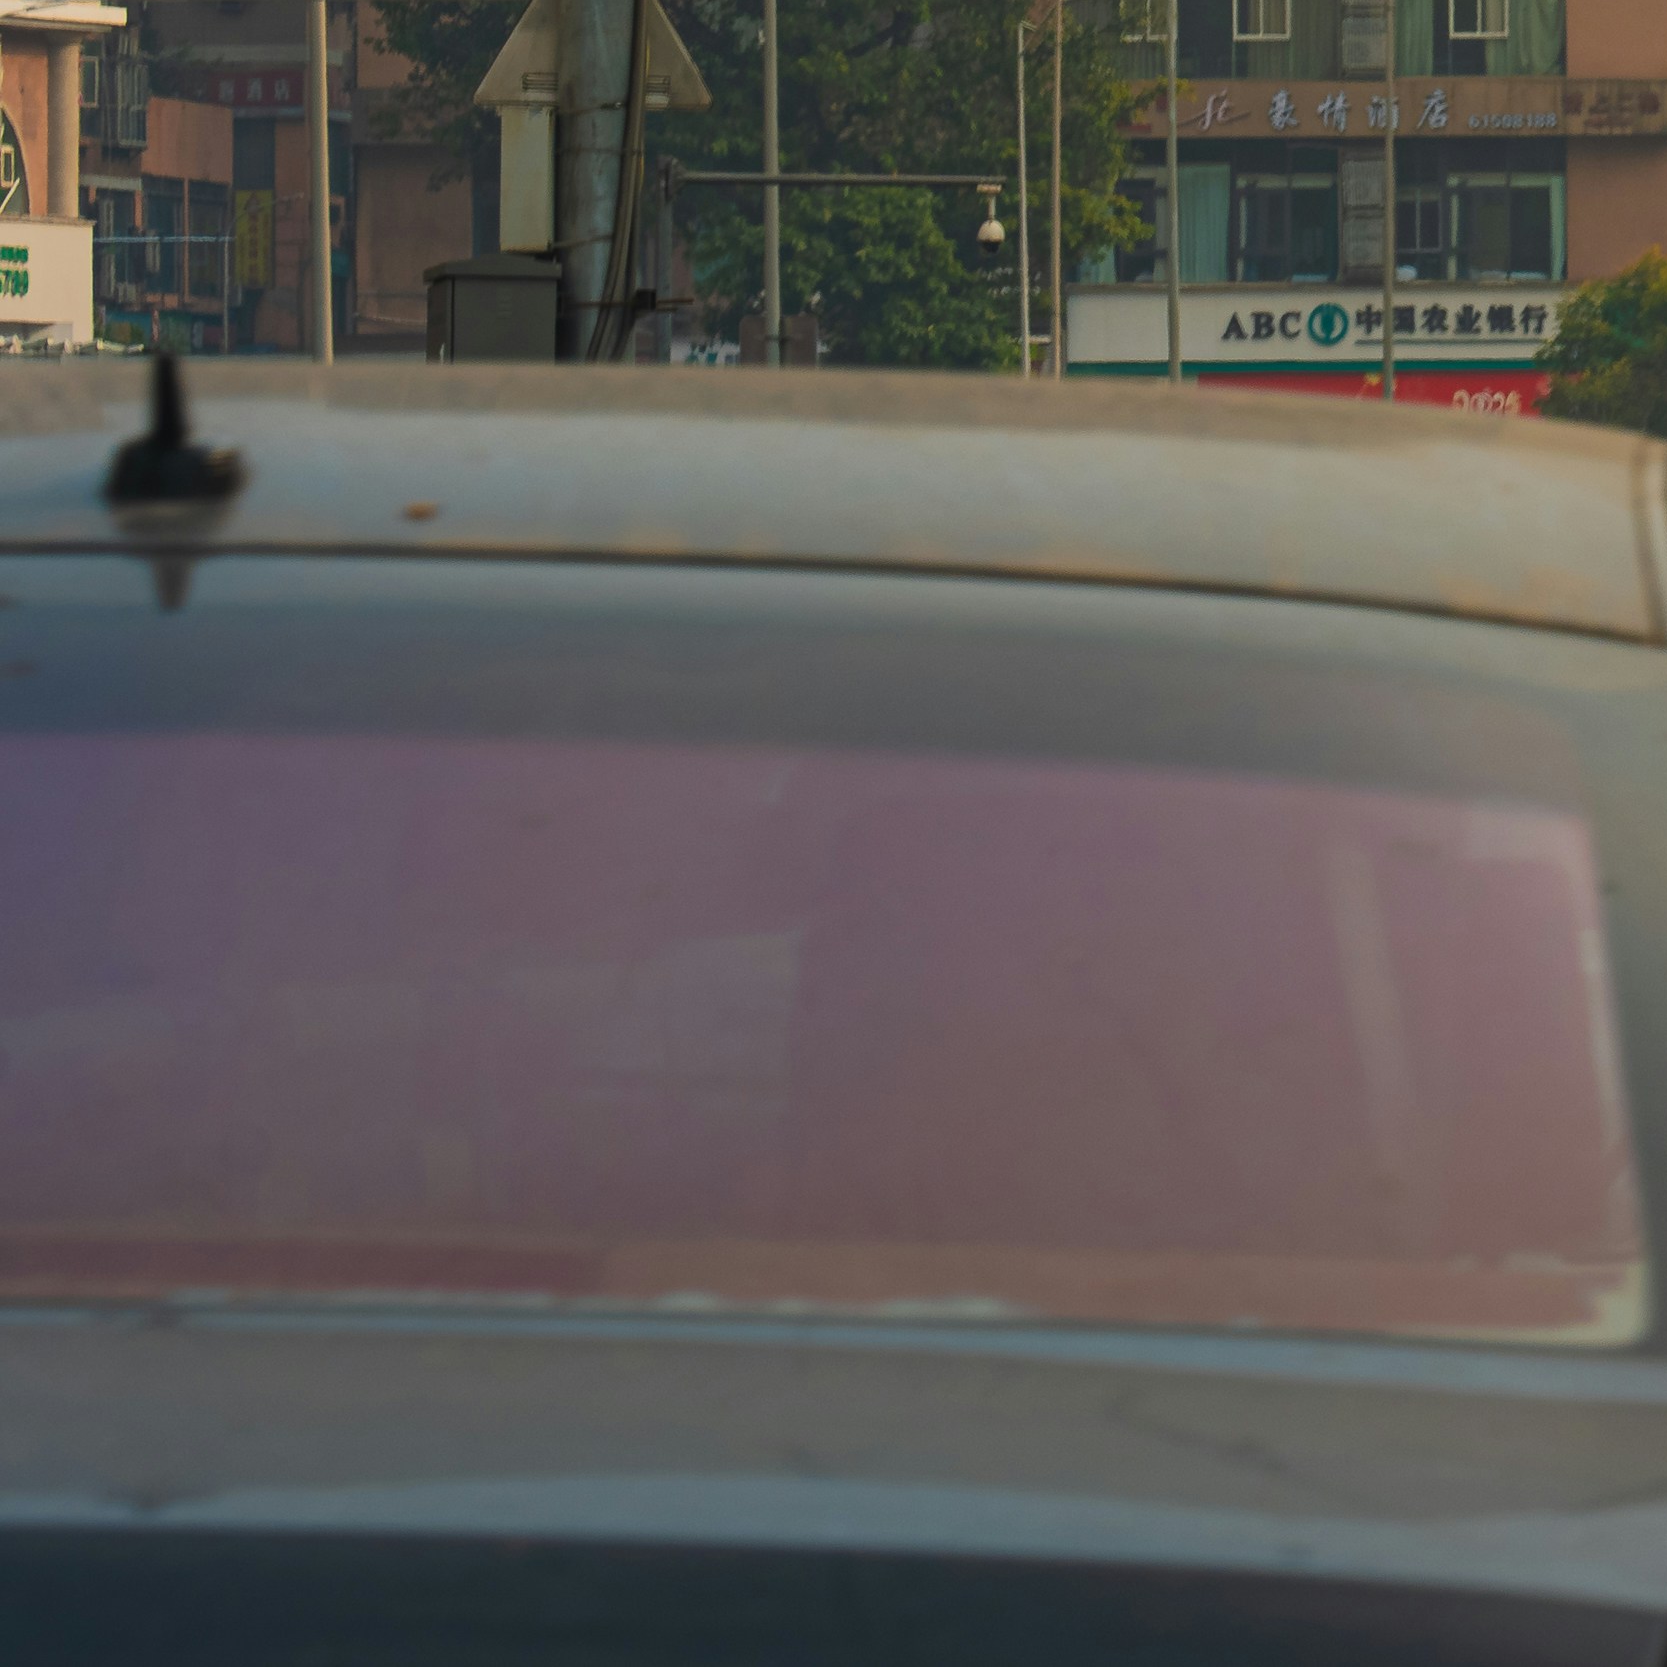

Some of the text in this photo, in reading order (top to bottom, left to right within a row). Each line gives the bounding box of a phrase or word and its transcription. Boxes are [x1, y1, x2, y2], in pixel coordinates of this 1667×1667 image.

[1221, 310, 1302, 341] ABC
[1355, 303, 1548, 335] 中国农业银行
